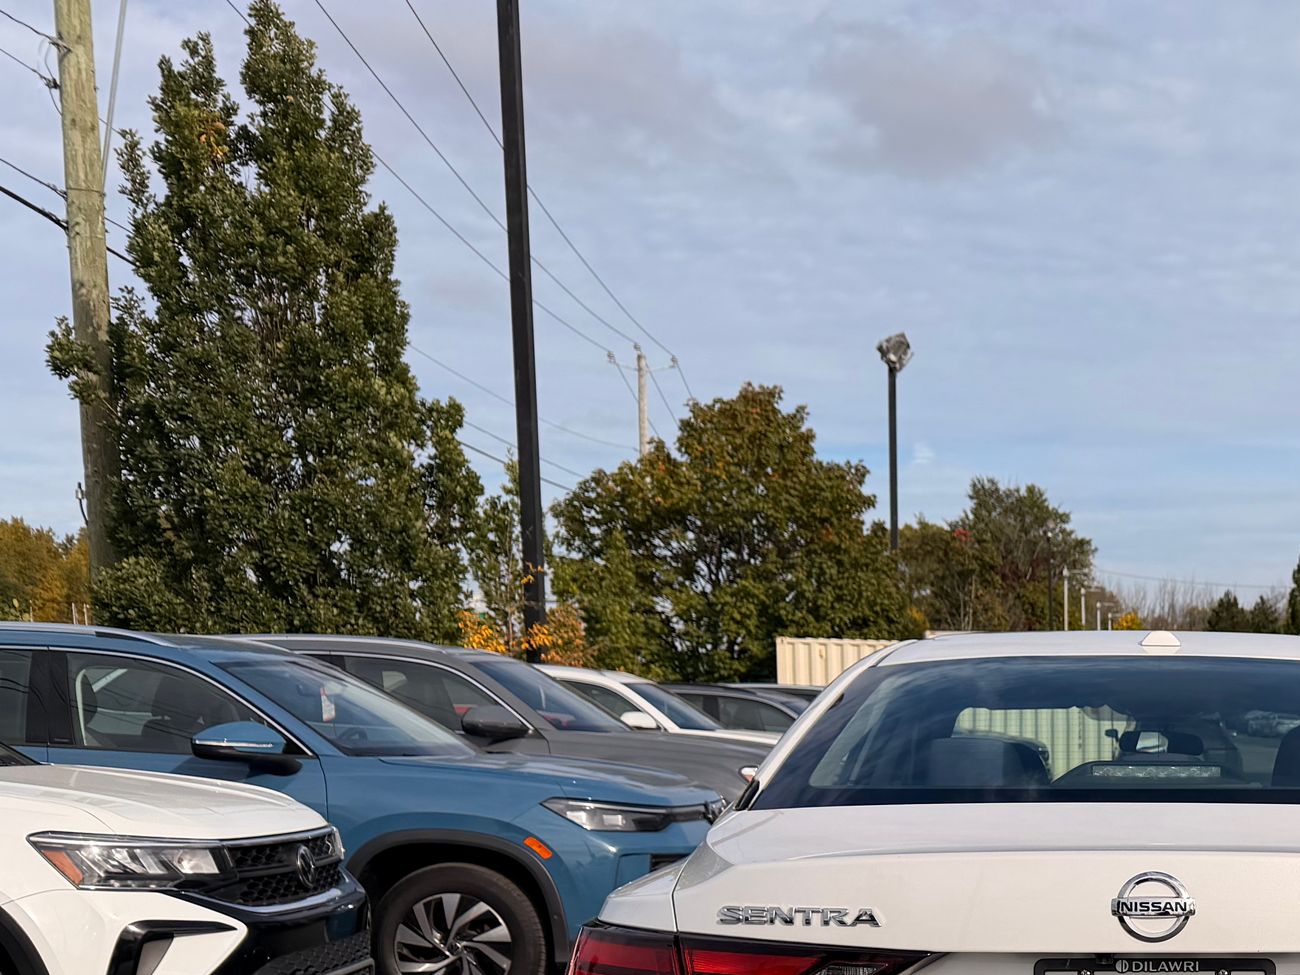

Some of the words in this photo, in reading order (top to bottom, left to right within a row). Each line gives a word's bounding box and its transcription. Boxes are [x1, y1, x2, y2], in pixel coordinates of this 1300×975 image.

[1120, 901, 1187, 912] NISSAN
[718, 905, 882, 928] SENTRA
[1131, 960, 1199, 972] DILAWRI
